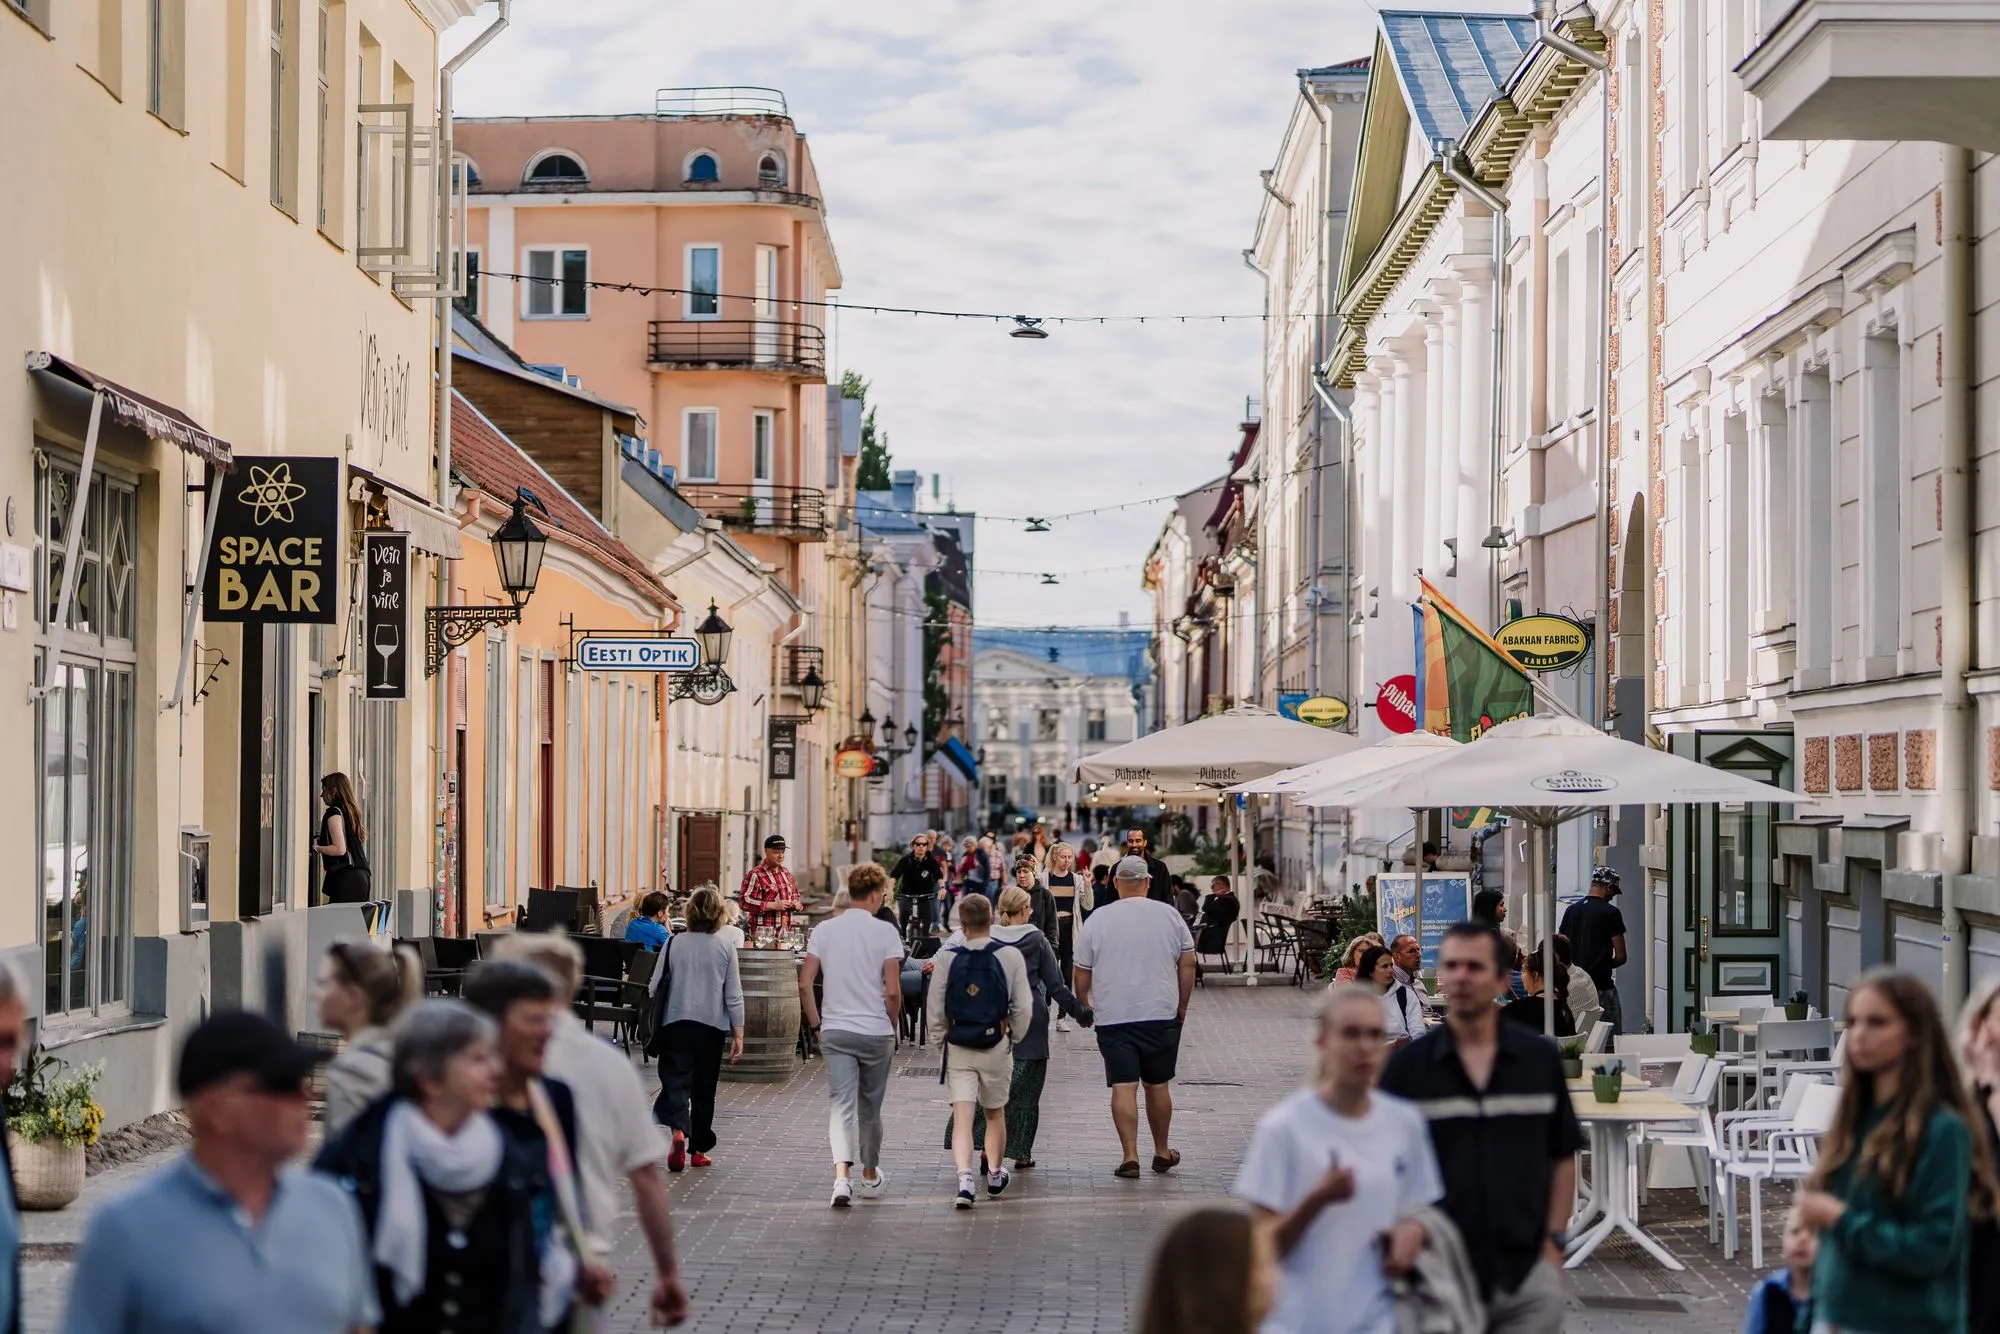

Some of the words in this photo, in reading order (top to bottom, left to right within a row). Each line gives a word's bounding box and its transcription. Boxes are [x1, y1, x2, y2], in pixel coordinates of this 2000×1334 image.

[220, 536, 322, 566] SPACE
[379, 568, 392, 588] ja
[219, 568, 321, 612] BAR
[1502, 635, 1542, 646] ABAKHAN
[1544, 634, 1580, 645] FABRICS
[588, 646, 632, 662] EESTI
[639, 647, 688, 663] OPTIK
